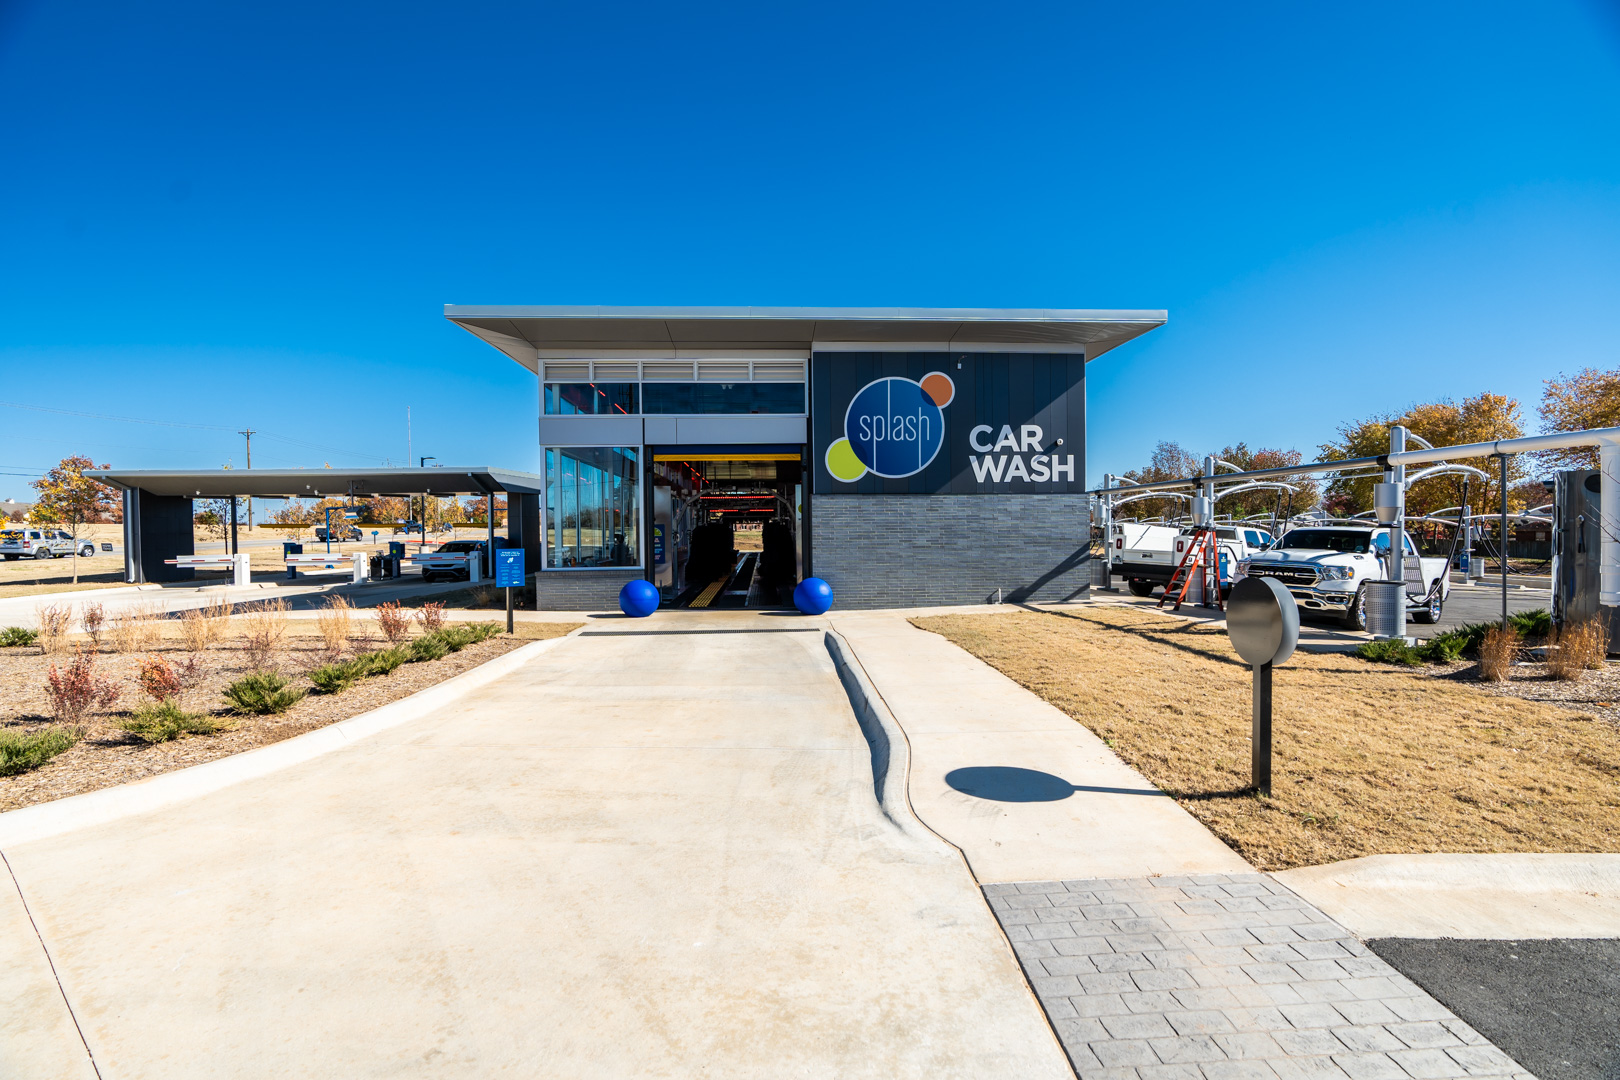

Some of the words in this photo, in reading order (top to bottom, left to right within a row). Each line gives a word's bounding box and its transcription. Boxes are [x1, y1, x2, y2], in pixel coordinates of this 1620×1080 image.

[859, 379, 930, 472] splash
[969, 424, 1044, 453] CAR
[968, 454, 1075, 483] WASH
